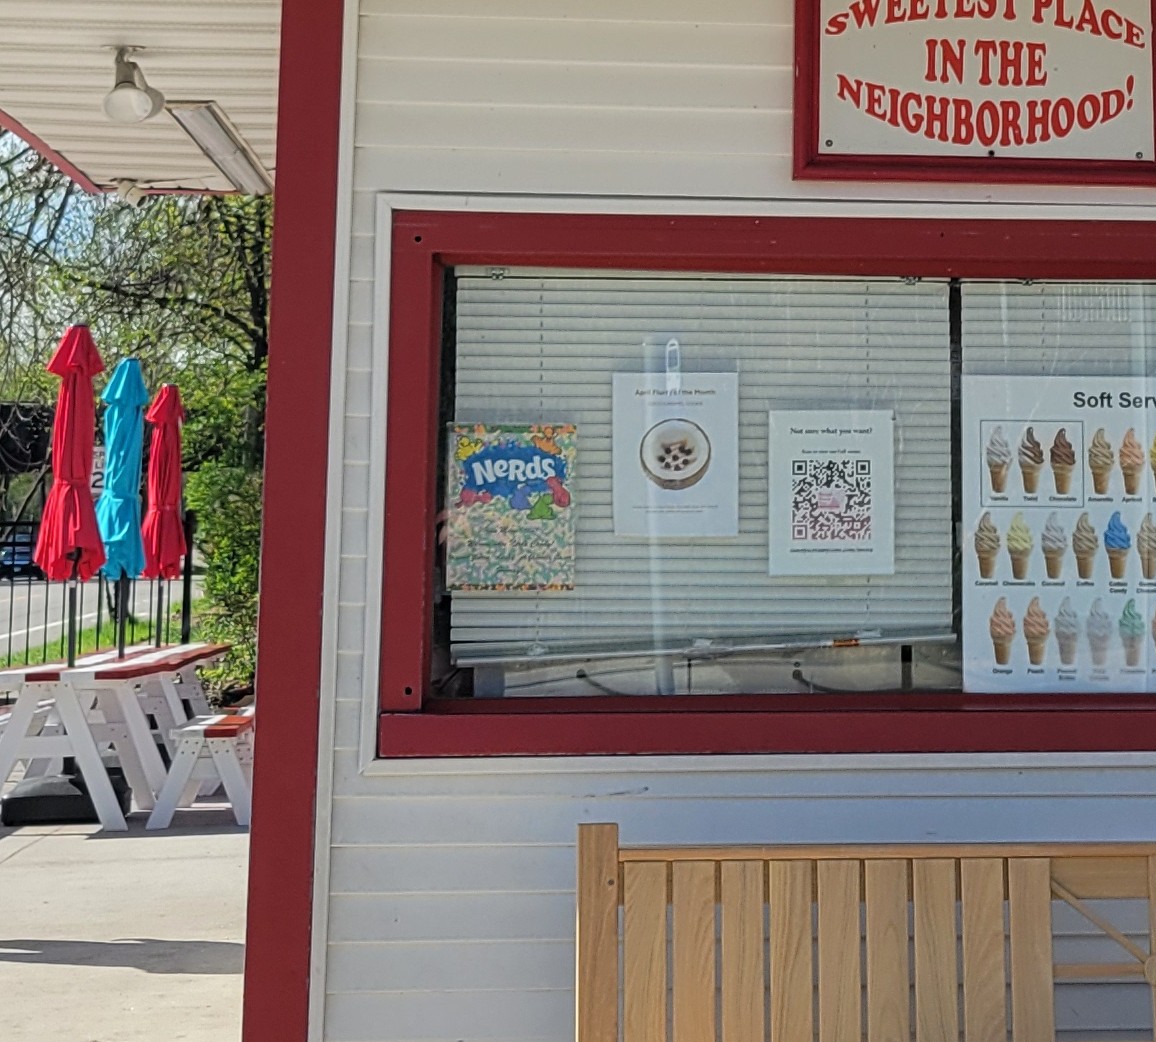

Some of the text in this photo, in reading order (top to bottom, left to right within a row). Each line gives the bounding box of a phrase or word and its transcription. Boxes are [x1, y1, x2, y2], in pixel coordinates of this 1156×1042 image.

[1032, 0, 1145, 48] PLACE
[925, 39, 1046, 86] IN THE
[837, 75, 1134, 146] NEIGHBORHOOD!
[1073, 391, 1112, 409] Soft
[91, 471, 104, 488] 2
